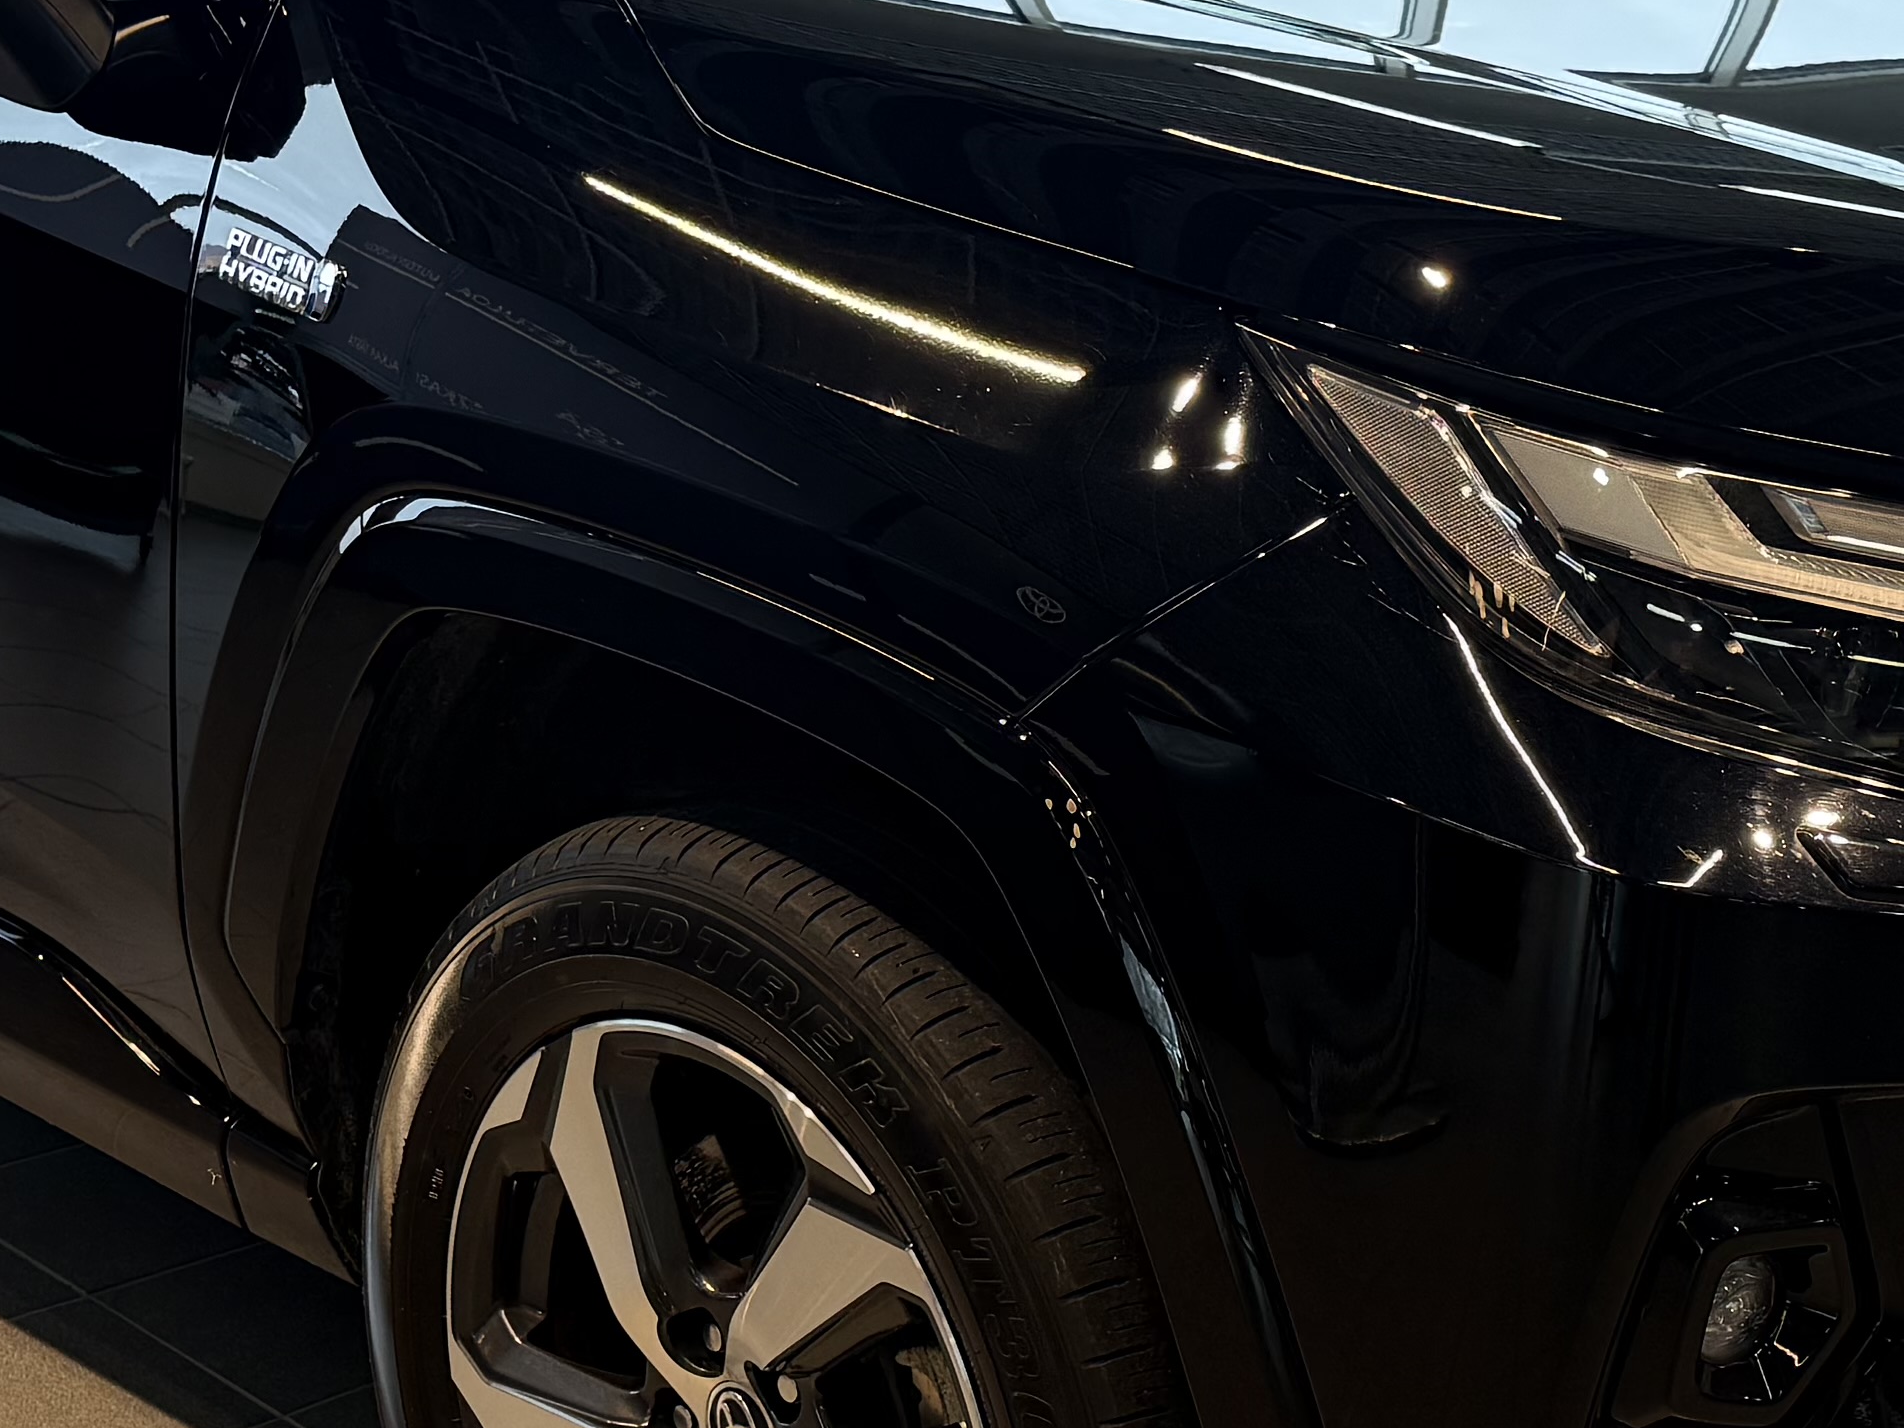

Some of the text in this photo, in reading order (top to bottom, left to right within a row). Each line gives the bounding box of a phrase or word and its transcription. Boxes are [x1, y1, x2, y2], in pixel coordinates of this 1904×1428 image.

[219, 252, 306, 309] HYBRID
[227, 227, 316, 283] PLUG-IN
[461, 900, 911, 1130] GRANDTREK
